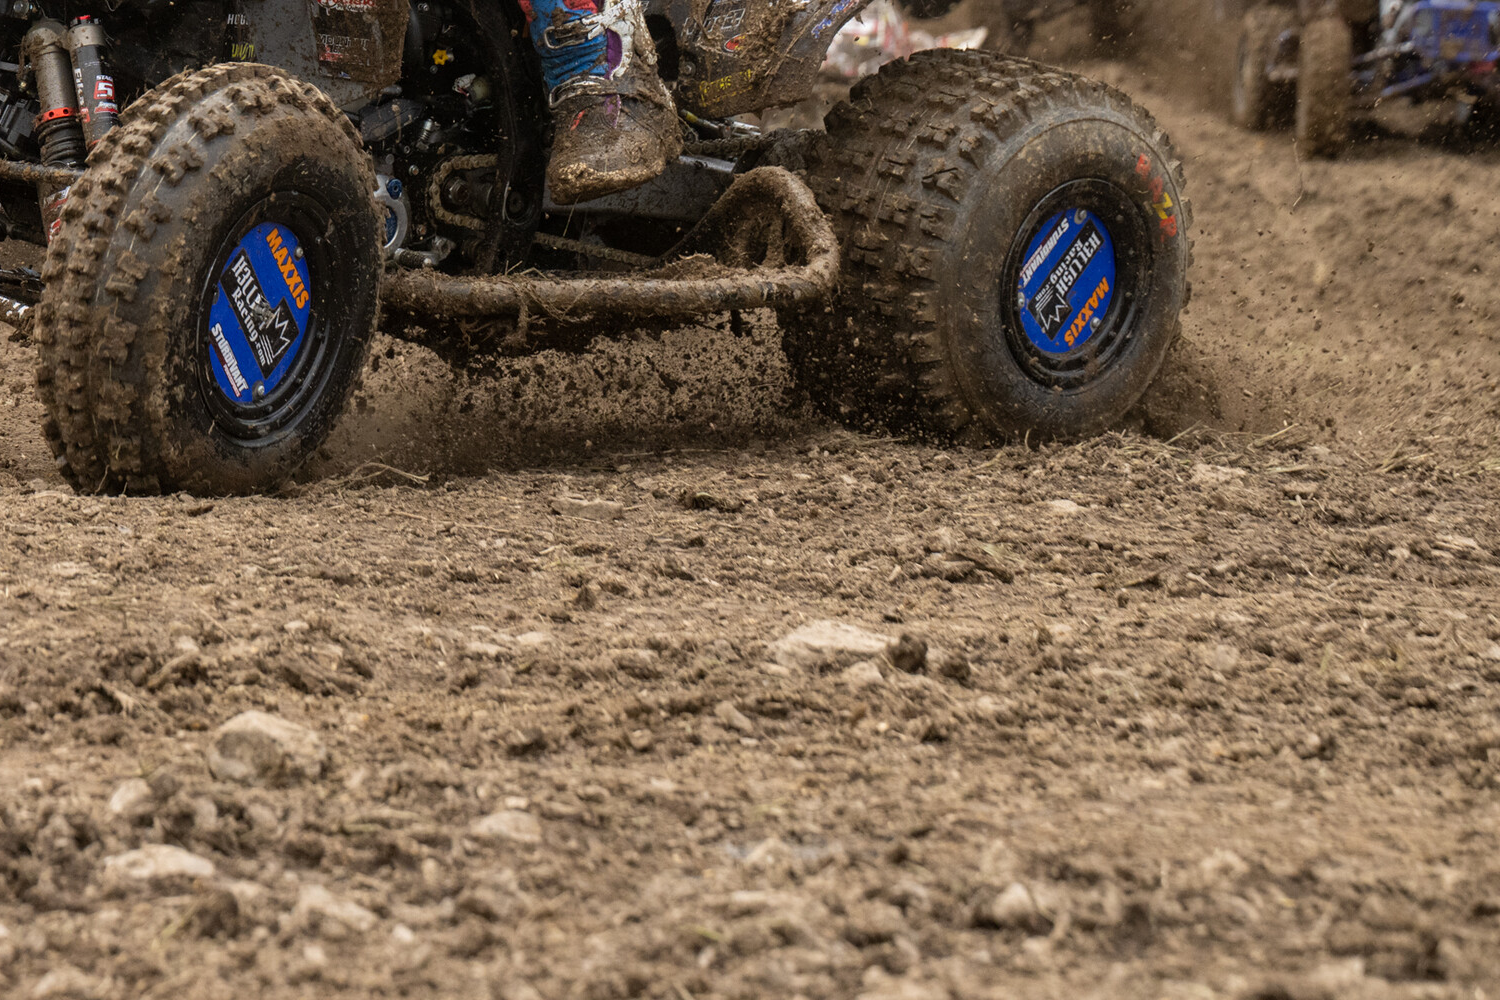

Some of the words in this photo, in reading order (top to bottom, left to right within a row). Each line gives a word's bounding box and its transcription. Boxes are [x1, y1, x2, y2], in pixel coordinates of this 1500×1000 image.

[266, 228, 309, 309] MAXXIS
[1022, 218, 1069, 288] STURDIVANT
[1035, 238, 1083, 301] Racing.com
[231, 287, 266, 366] Racing.com
[1064, 277, 1110, 347] MAXXIS
[211, 322, 249, 391] STURDIVANT
